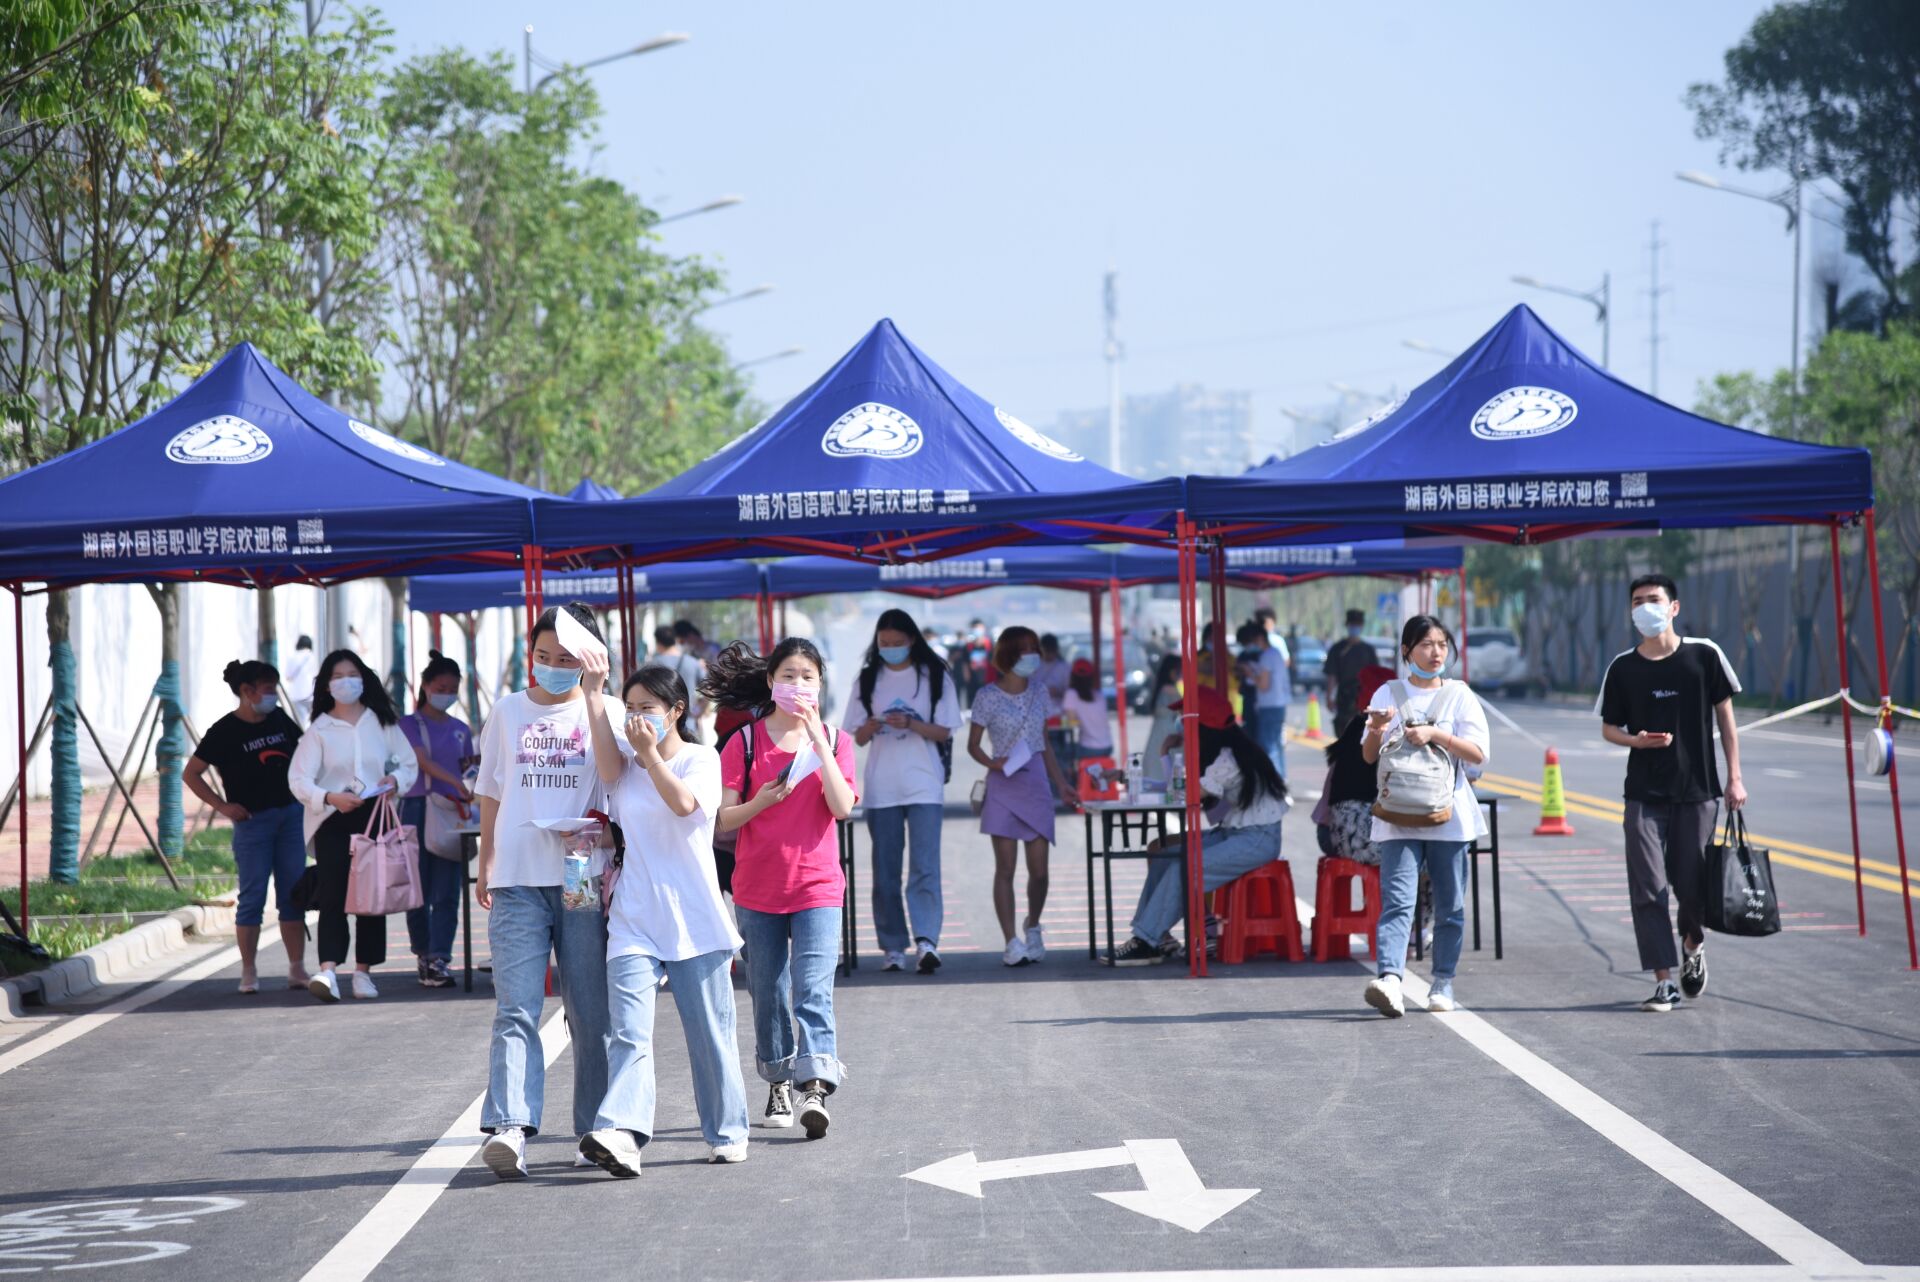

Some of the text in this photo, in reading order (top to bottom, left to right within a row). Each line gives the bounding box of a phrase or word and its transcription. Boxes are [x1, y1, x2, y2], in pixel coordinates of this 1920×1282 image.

[737, 488, 934, 521] 湖南外国语职业学院欢迎您
[1404, 480, 1609, 512] 湖南外国语职业学院欢迎您
[82, 525, 288, 558] 湖南外国语职业学院欢迎您
[524, 736, 578, 751] COUTURE
[533, 754, 566, 768] IS AN
[521, 773, 579, 789] ATTITUDE
